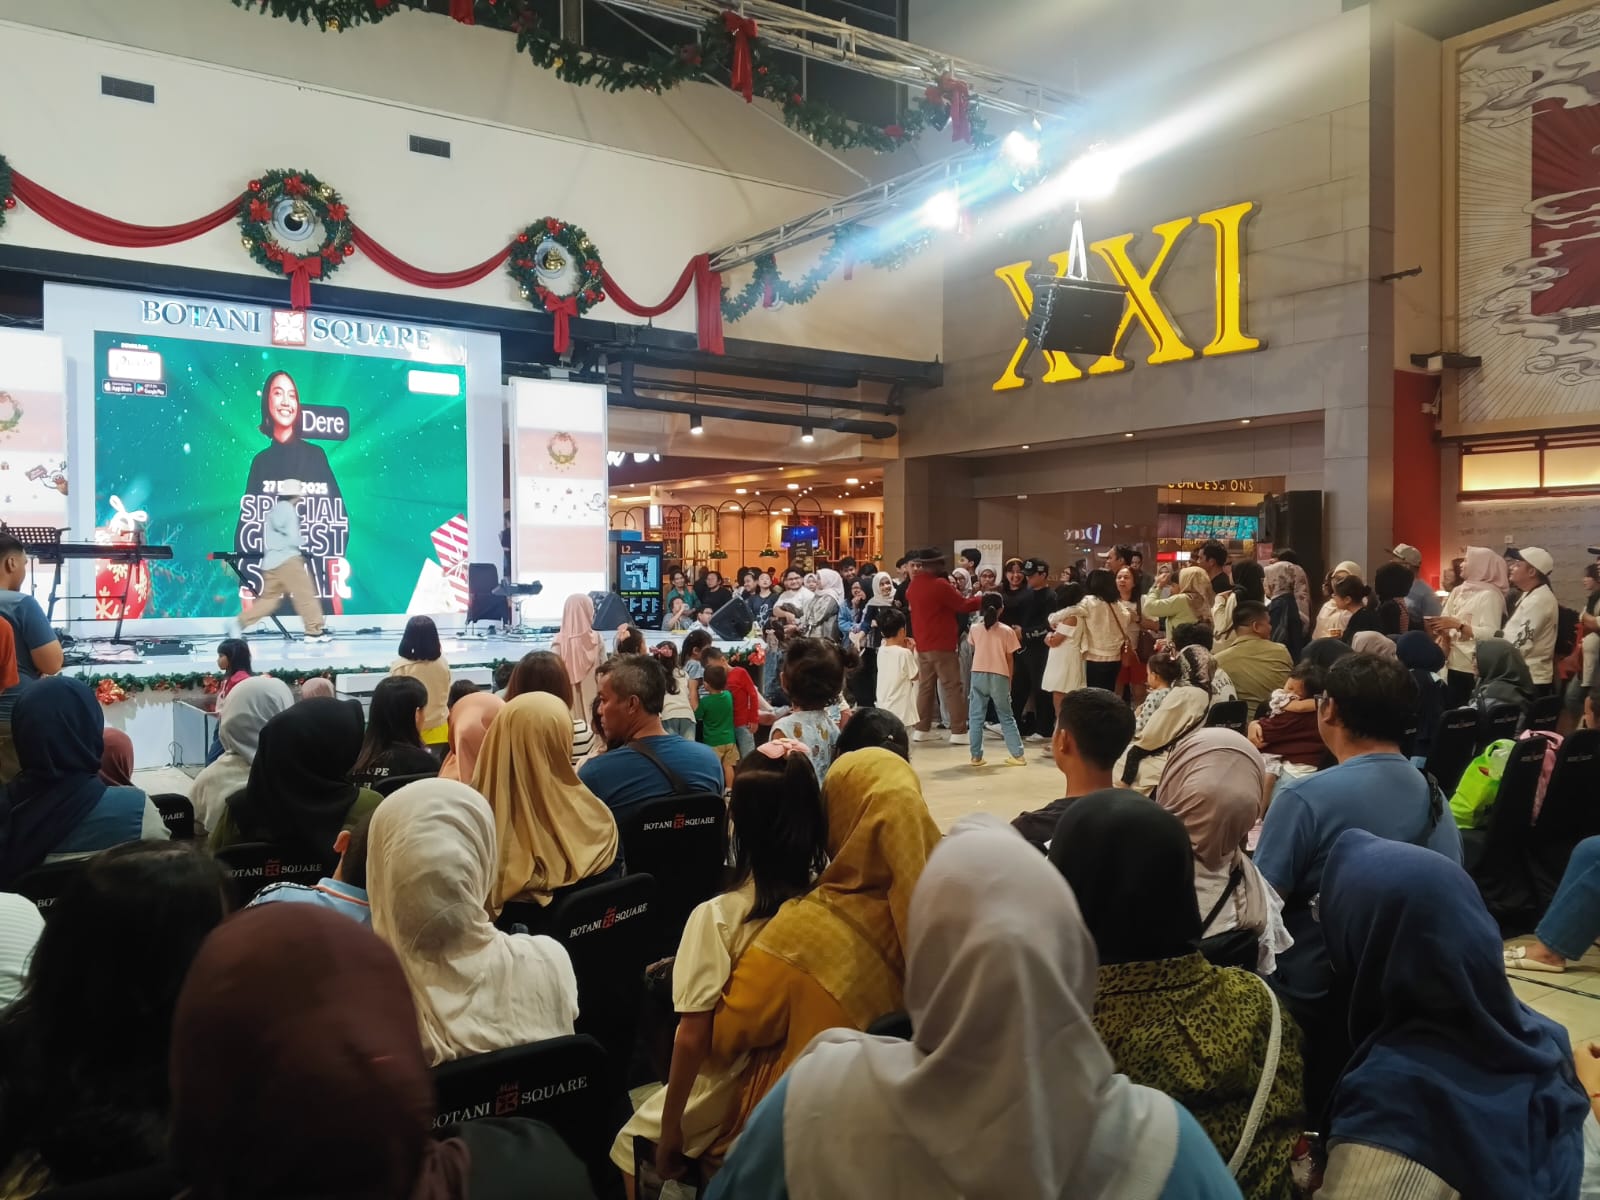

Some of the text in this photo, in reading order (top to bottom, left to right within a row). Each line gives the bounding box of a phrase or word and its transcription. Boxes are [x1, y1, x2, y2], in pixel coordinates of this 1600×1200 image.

[992, 201, 1260, 391] XXI
[141, 300, 432, 350] BOTANI SQUARE
[302, 410, 345, 434] Dere
[262, 480, 276, 493] 27
[240, 495, 348, 524] SPCIAL
[240, 522, 350, 557] GEST
[643, 816, 715, 831] BOTANI SQUARE
[281, 863, 322, 874] SQUARE
[569, 919, 602, 938] BOTANI
[615, 903, 648, 923] SQUARE
[521, 1076, 588, 1105] SQUARE
